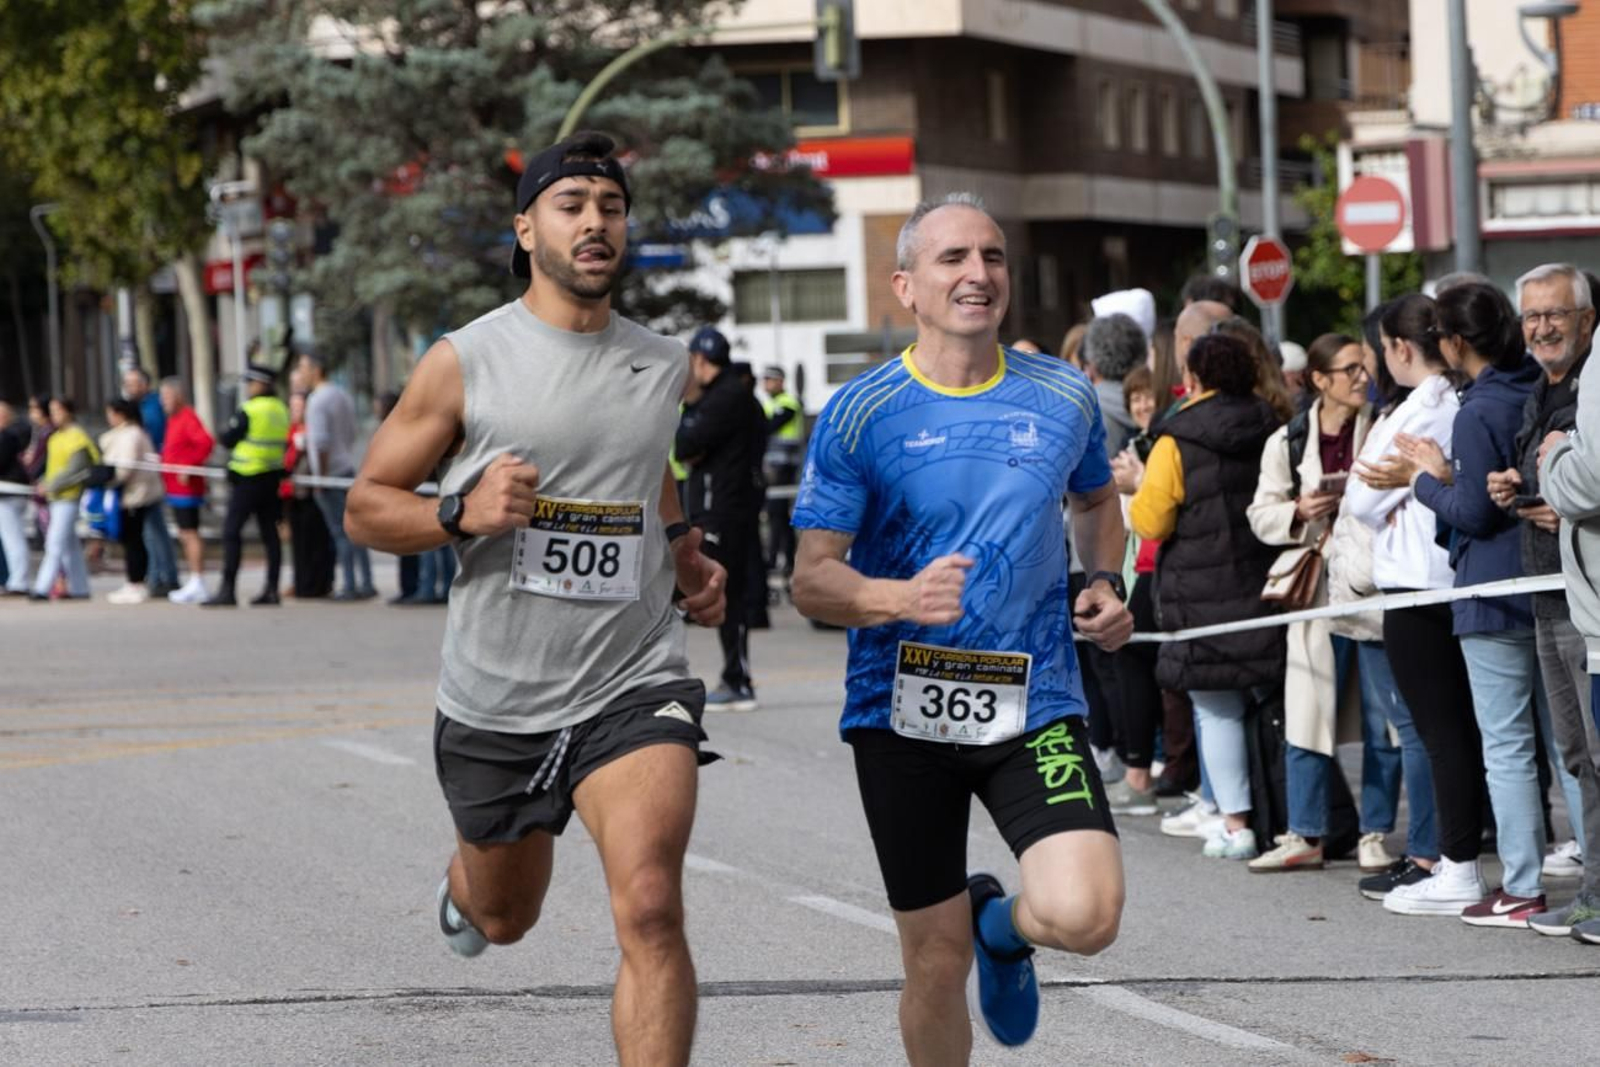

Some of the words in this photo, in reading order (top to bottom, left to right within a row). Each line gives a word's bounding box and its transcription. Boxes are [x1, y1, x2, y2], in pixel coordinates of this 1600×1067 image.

[1250, 259, 1289, 282] STOP
[569, 513, 597, 523] gran
[542, 538, 621, 578] 508
[903, 647, 932, 666] XXV
[933, 651, 978, 664] CARRERA
[979, 656, 1025, 666] POPULAR
[944, 661, 971, 671] gran
[976, 663, 1024, 674] caminata
[920, 684, 997, 723] 363
